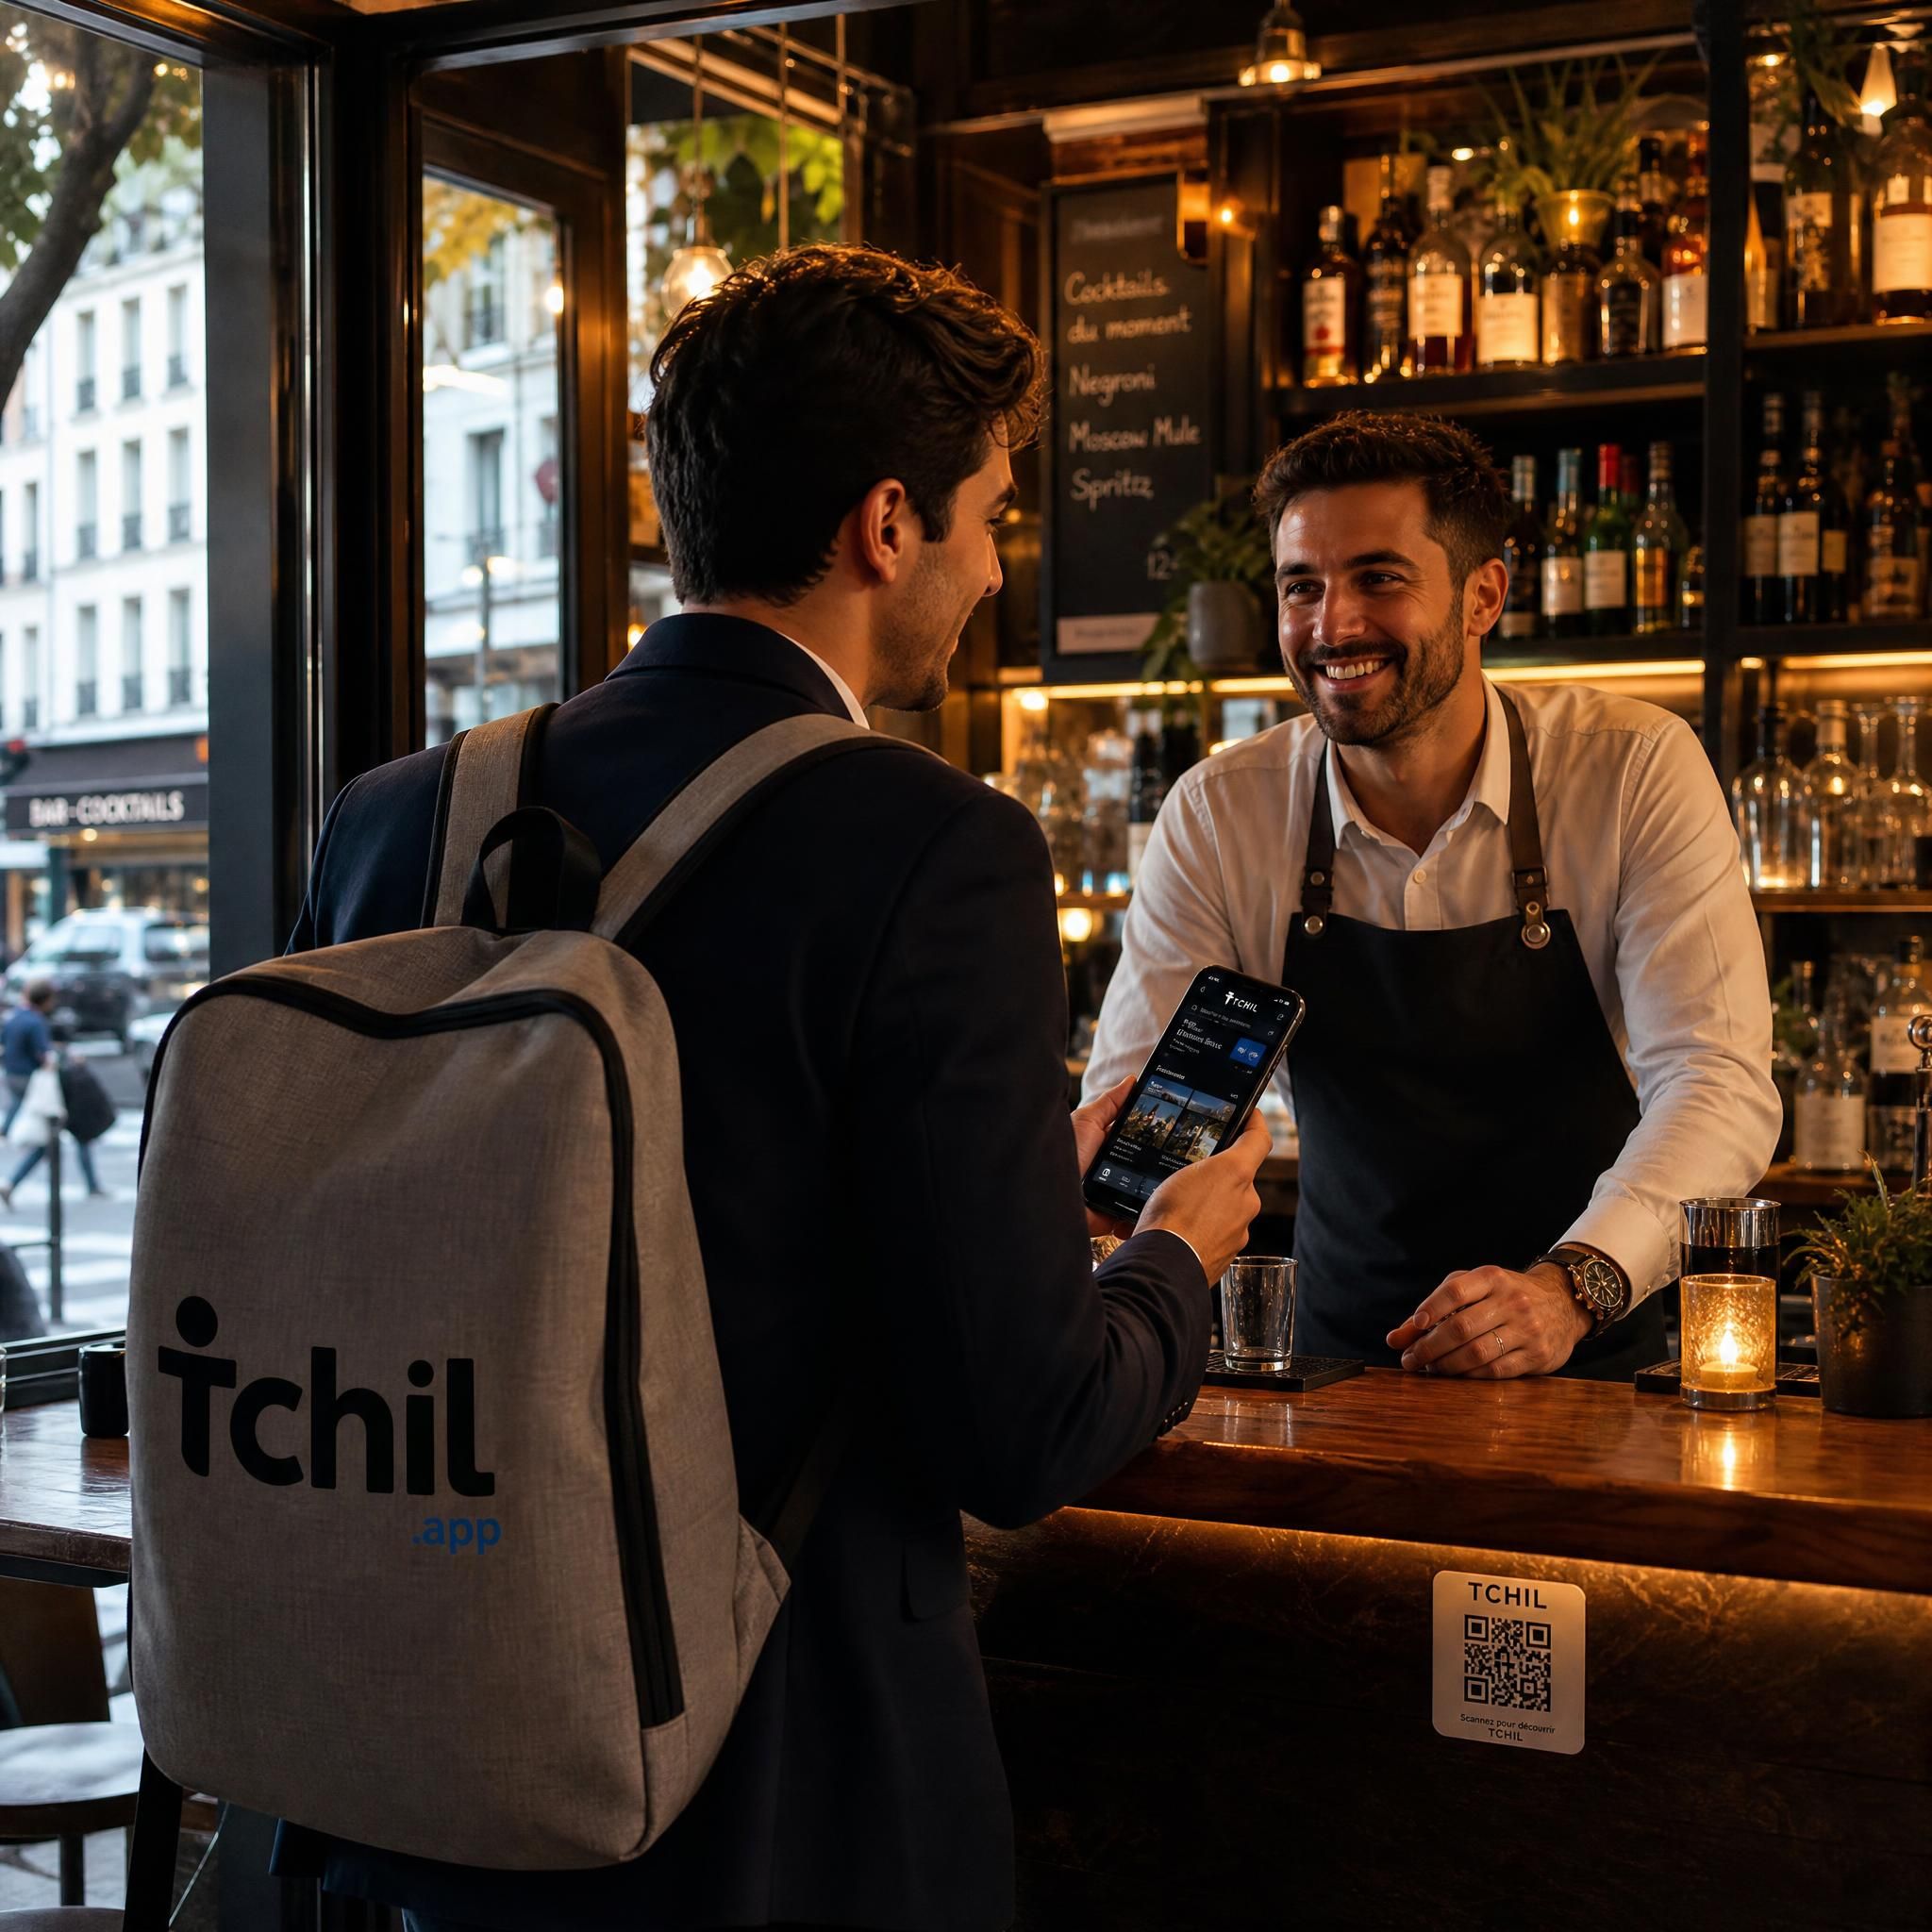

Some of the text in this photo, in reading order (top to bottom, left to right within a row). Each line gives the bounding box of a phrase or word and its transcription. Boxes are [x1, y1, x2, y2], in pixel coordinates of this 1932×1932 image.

[1064, 268, 1170, 306] Cocktails
[1067, 304, 1192, 344] du moment
[1069, 363, 1157, 408] Negroni
[1069, 414, 1201, 453] Moscow Mule
[158, 1295, 495, 1497] Tchil
[411, 1516, 502, 1556] .app
[1468, 1582, 1547, 1608] TCHIL
[1460, 1713, 1494, 1725] Scannez
[1496, 1720, 1516, 1728] pour
[1489, 1727, 1524, 1741] TCHIL
